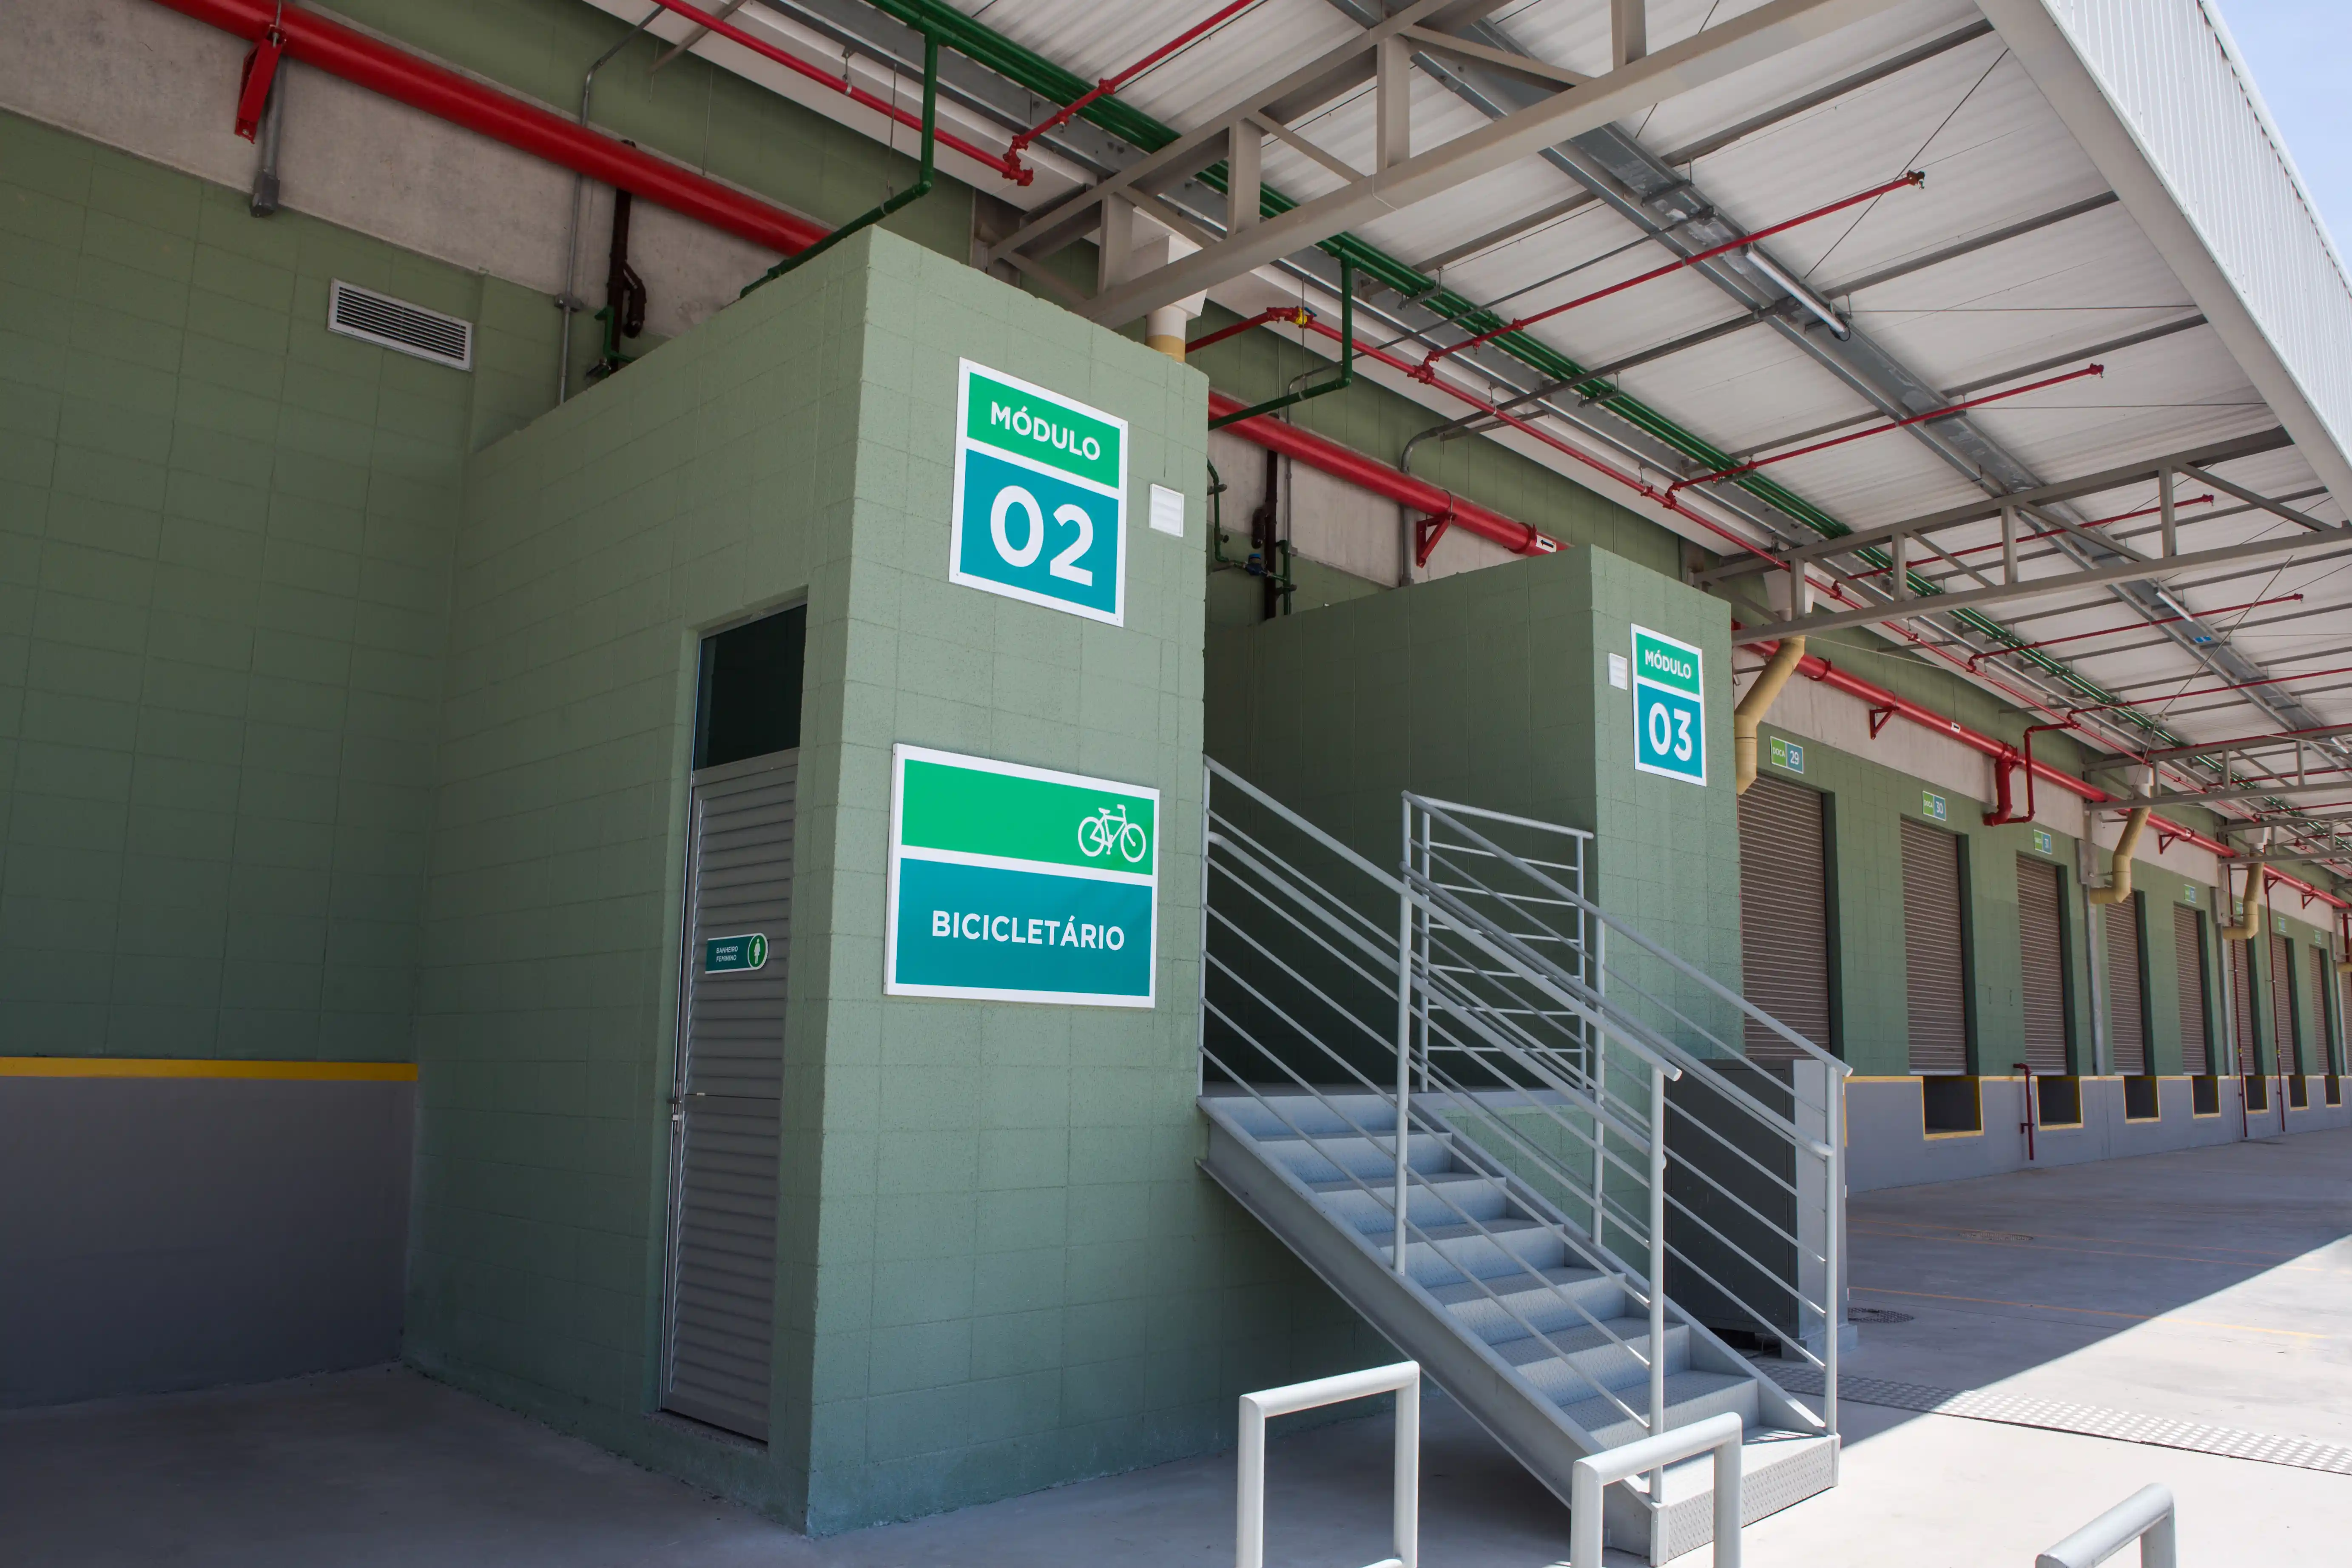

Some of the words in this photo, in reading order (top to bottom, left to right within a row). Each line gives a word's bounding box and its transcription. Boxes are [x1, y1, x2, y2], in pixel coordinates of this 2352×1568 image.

[991, 401, 1100, 461] MÓDULO
[990, 485, 1093, 586] 02
[1645, 649, 1691, 679] MÓDULO
[1648, 702, 1692, 762] 03
[1772, 747, 1785, 757] DOCA
[1790, 750, 1799, 765] 29
[1936, 801, 1944, 814] 30
[933, 911, 1125, 951] BICICLETÁRIO
